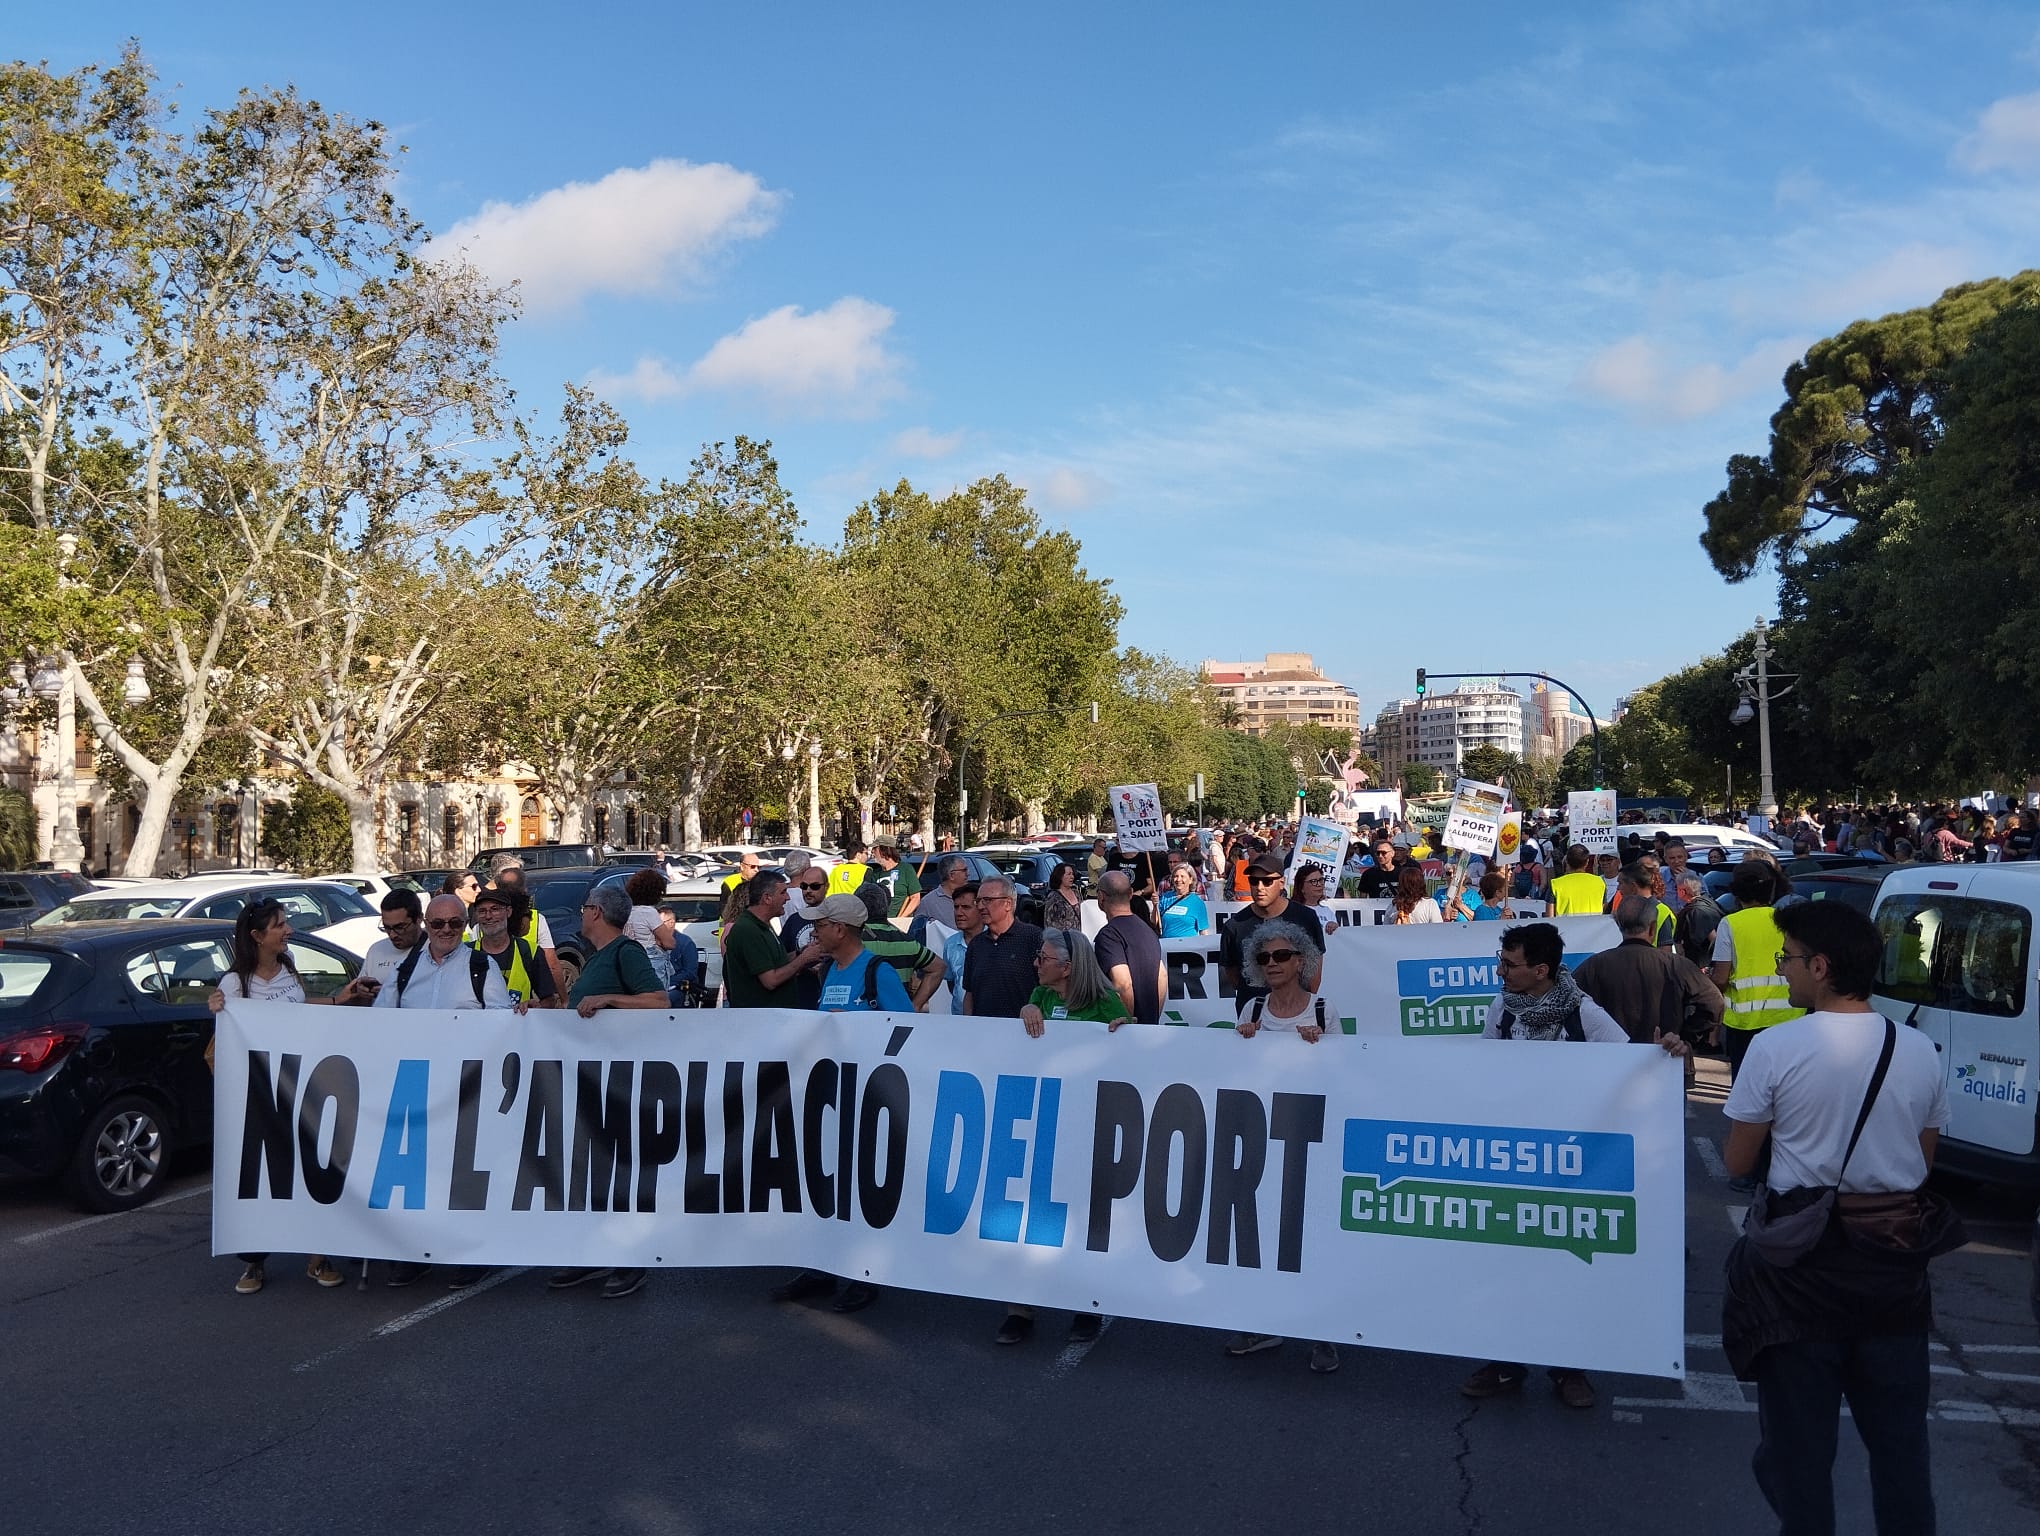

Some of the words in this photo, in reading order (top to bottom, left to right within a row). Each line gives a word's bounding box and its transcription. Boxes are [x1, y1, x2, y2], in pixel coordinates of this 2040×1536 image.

[1128, 818, 1158, 828] PORT
[1461, 819, 1494, 834] PORT
[1130, 829, 1163, 839] SALUT
[1582, 827, 1612, 836] PORT
[1580, 836, 1615, 844] CIUTAT
[1979, 1052, 2027, 1067] RENAULT
[1963, 1079, 2026, 1104] aqualia
[237, 1050, 360, 1204] NO
[368, 1060, 430, 1210] A
[448, 1026, 914, 1229] L'AMPLIACIÓ
[923, 1070, 1068, 1248] DEL
[1086, 1080, 1327, 1273] PORT
[1385, 1133, 1583, 1176] COMISSIÓ
